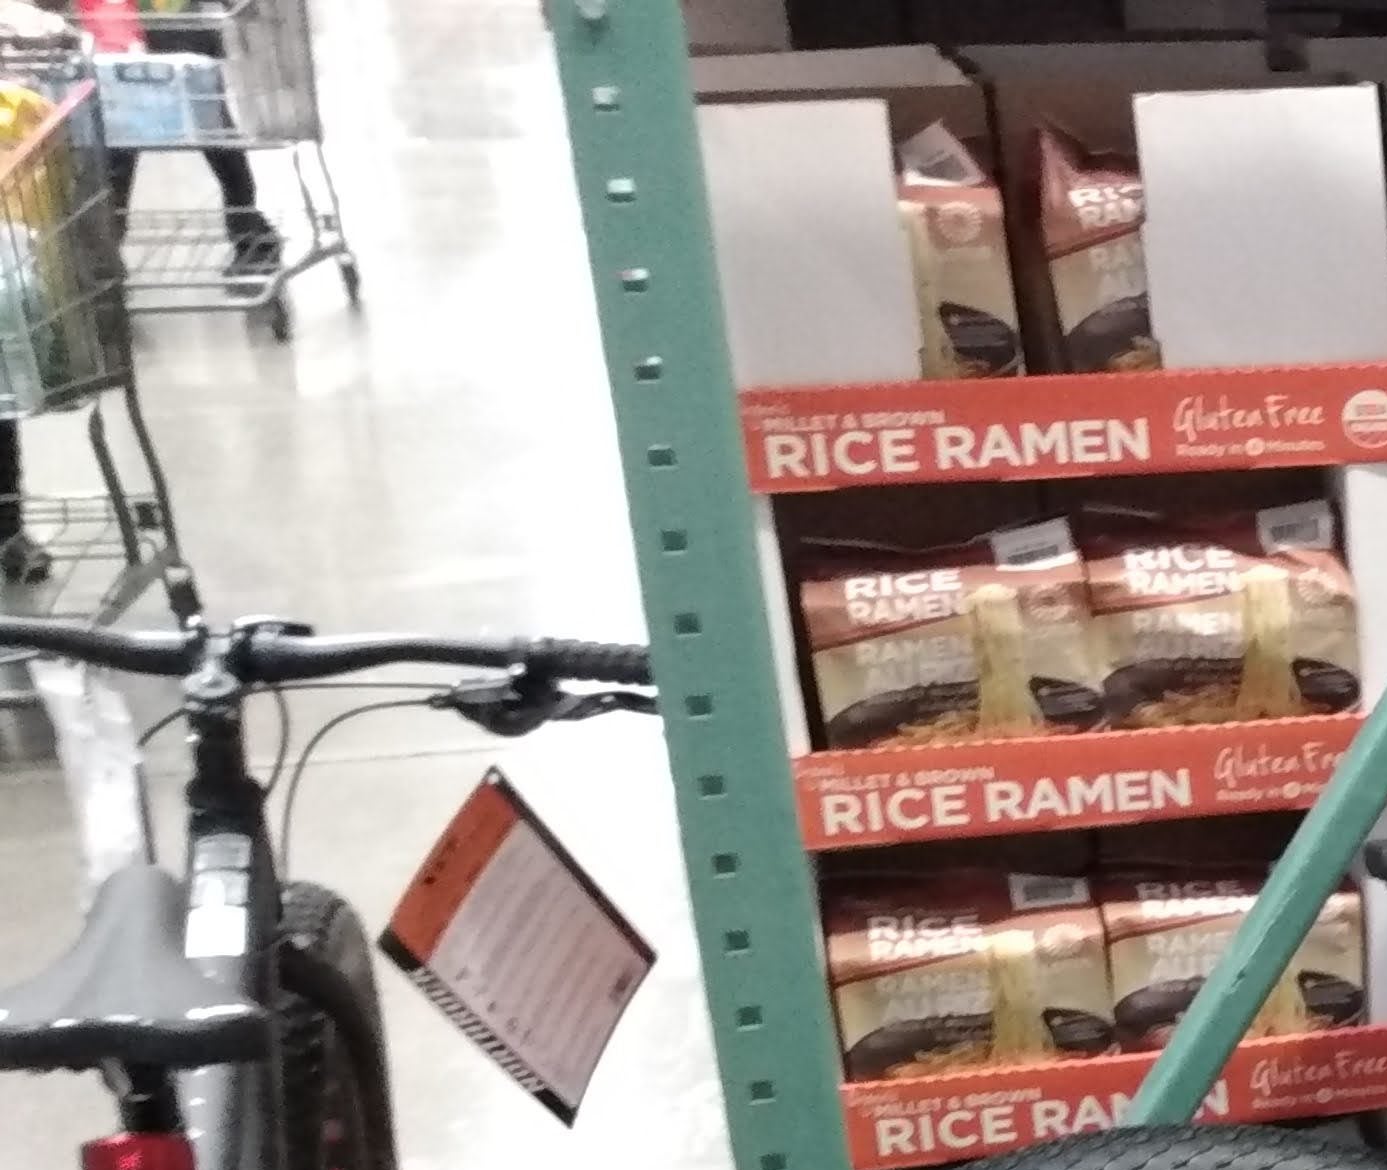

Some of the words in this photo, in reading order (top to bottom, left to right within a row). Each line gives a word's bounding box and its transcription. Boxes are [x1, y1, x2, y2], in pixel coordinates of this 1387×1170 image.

[1172, 394, 1264, 443] Gluten
[1264, 393, 1326, 429] Free
[762, 429, 921, 480] RICE
[933, 417, 1151, 472] RAMEN
[1123, 545, 1238, 570] RICE
[843, 568, 965, 602] RICE
[1126, 569, 1248, 596] RAMEN
[1212, 746, 1299, 787] Gluten
[820, 784, 972, 836] RICE
[983, 768, 1194, 824] RAMEN
[866, 914, 984, 941] RICE
[1250, 1058, 1332, 1098] Gluten
[874, 1105, 1018, 1158] RICE
[1030, 1078, 1230, 1139] RAN
